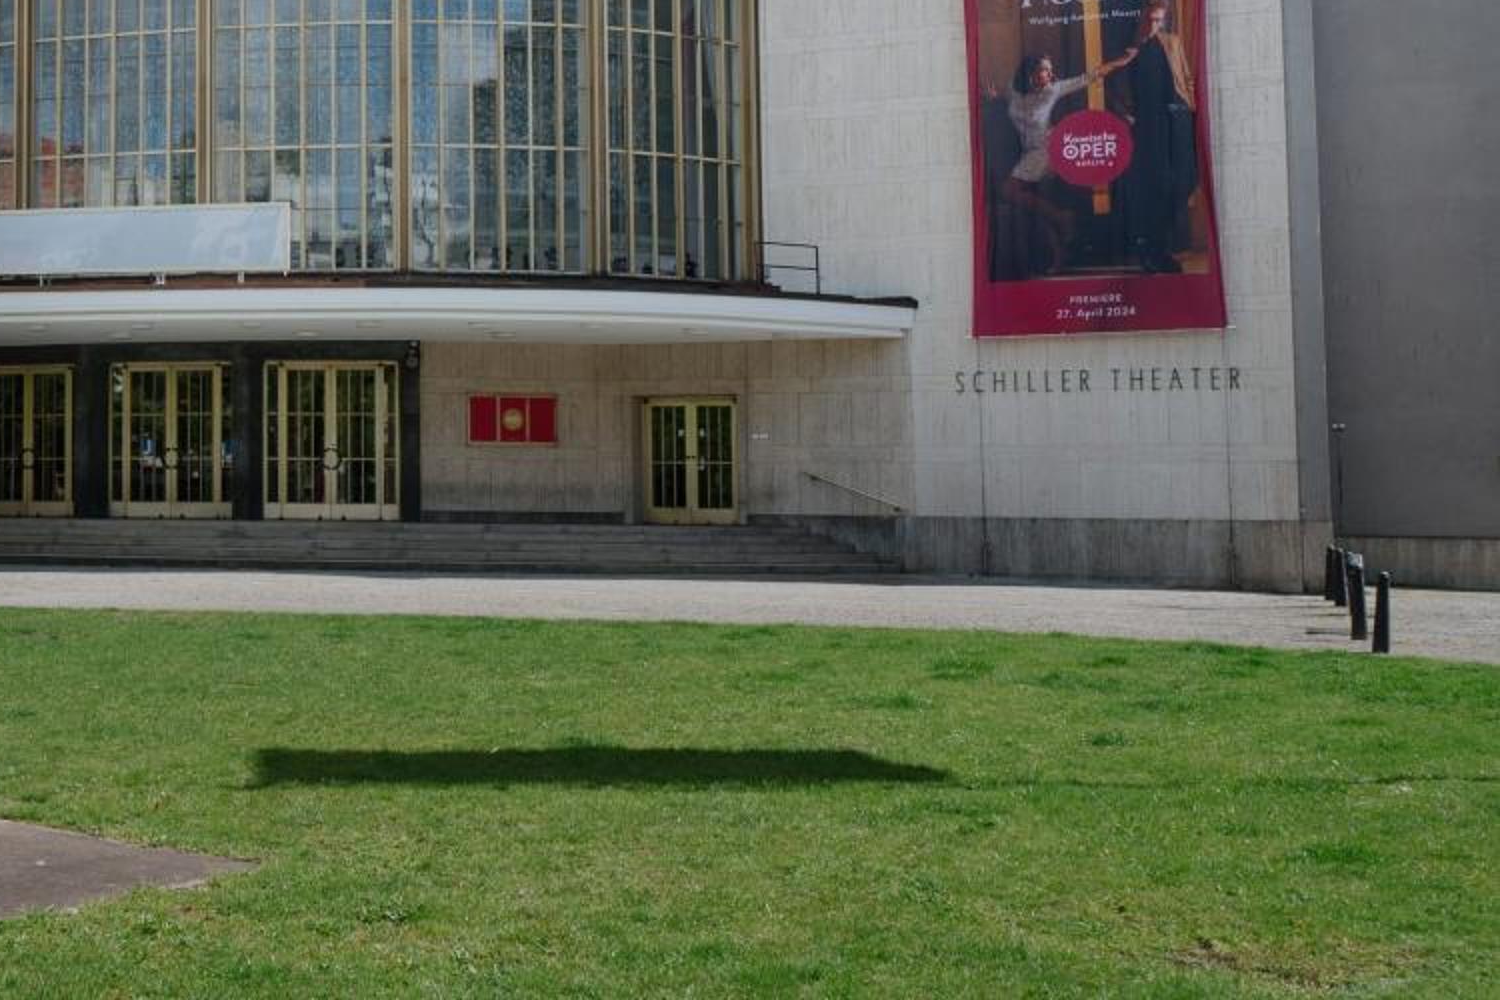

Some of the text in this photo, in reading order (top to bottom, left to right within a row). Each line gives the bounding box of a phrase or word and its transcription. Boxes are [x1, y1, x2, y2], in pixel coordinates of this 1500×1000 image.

[1063, 141, 1117, 160] OPER
[1077, 307, 1103, 321] April
[955, 367, 1241, 393] SCHILLER THEATER
